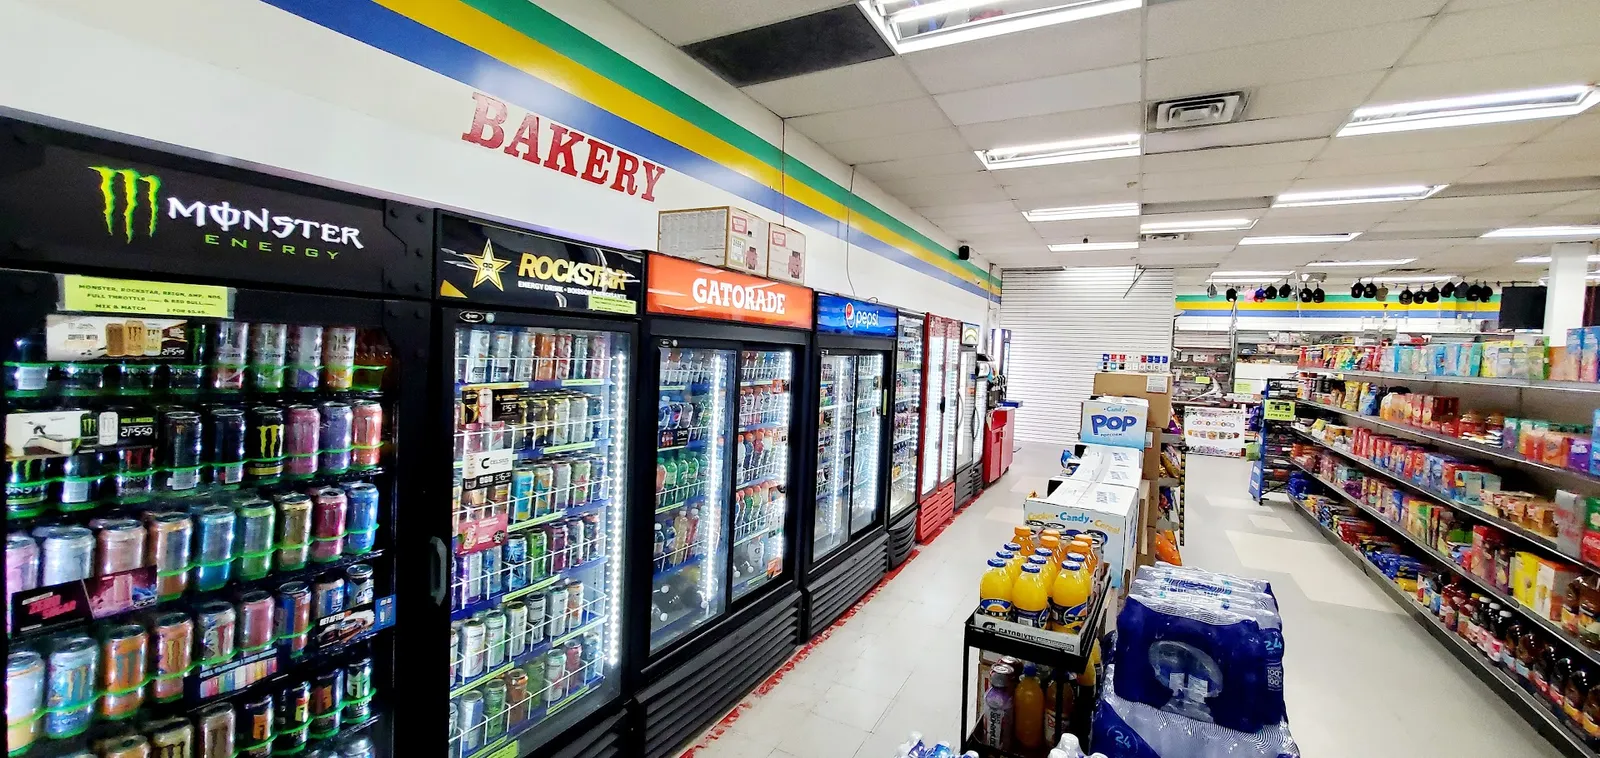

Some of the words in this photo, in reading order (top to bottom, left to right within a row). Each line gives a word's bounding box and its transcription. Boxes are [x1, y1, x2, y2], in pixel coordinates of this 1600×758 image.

[461, 92, 666, 202] BAKERY
[204, 234, 339, 261] ENERGY
[518, 252, 628, 291] ROCKSTAR
[517, 280, 544, 289] ENERGY
[692, 277, 786, 316] GATORADE
[855, 310, 880, 330] pepsi
[1106, 405, 1126, 413] Candy
[1091, 414, 1137, 435] POP
[1060, 511, 1090, 524] Candy
[1263, 637, 1283, 650] 24
[1113, 730, 1133, 749] 24
